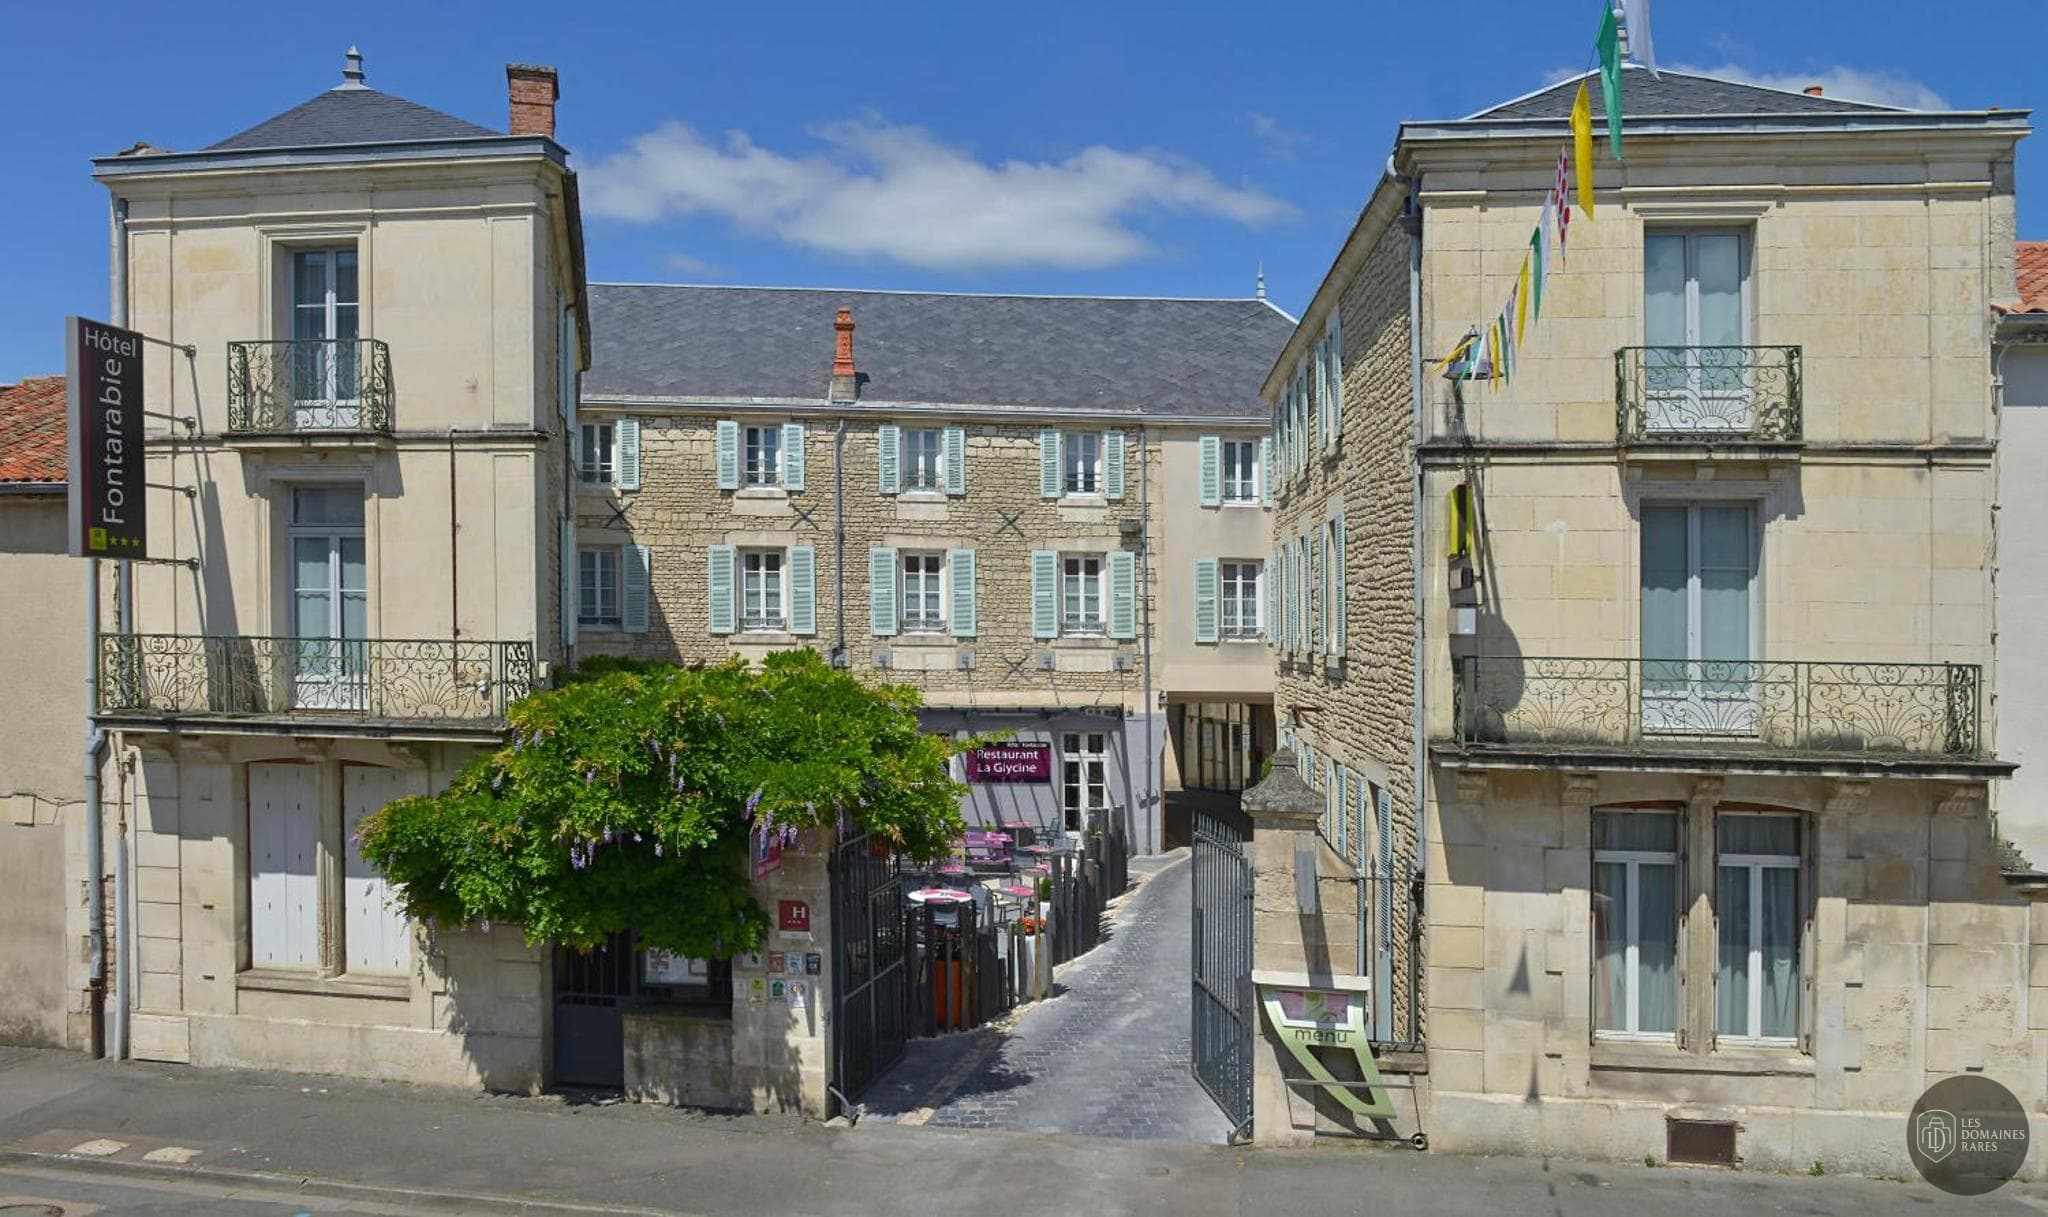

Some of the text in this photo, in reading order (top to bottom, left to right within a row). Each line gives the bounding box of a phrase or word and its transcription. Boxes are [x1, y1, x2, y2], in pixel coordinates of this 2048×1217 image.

[85, 327, 136, 358] Hôtel
[101, 358, 125, 524] Fontarabie
[977, 750, 1038, 760] Restaurant
[977, 762, 1037, 775] La Glycine
[793, 906, 805, 918] H
[1295, 1030, 1347, 1043] menu
